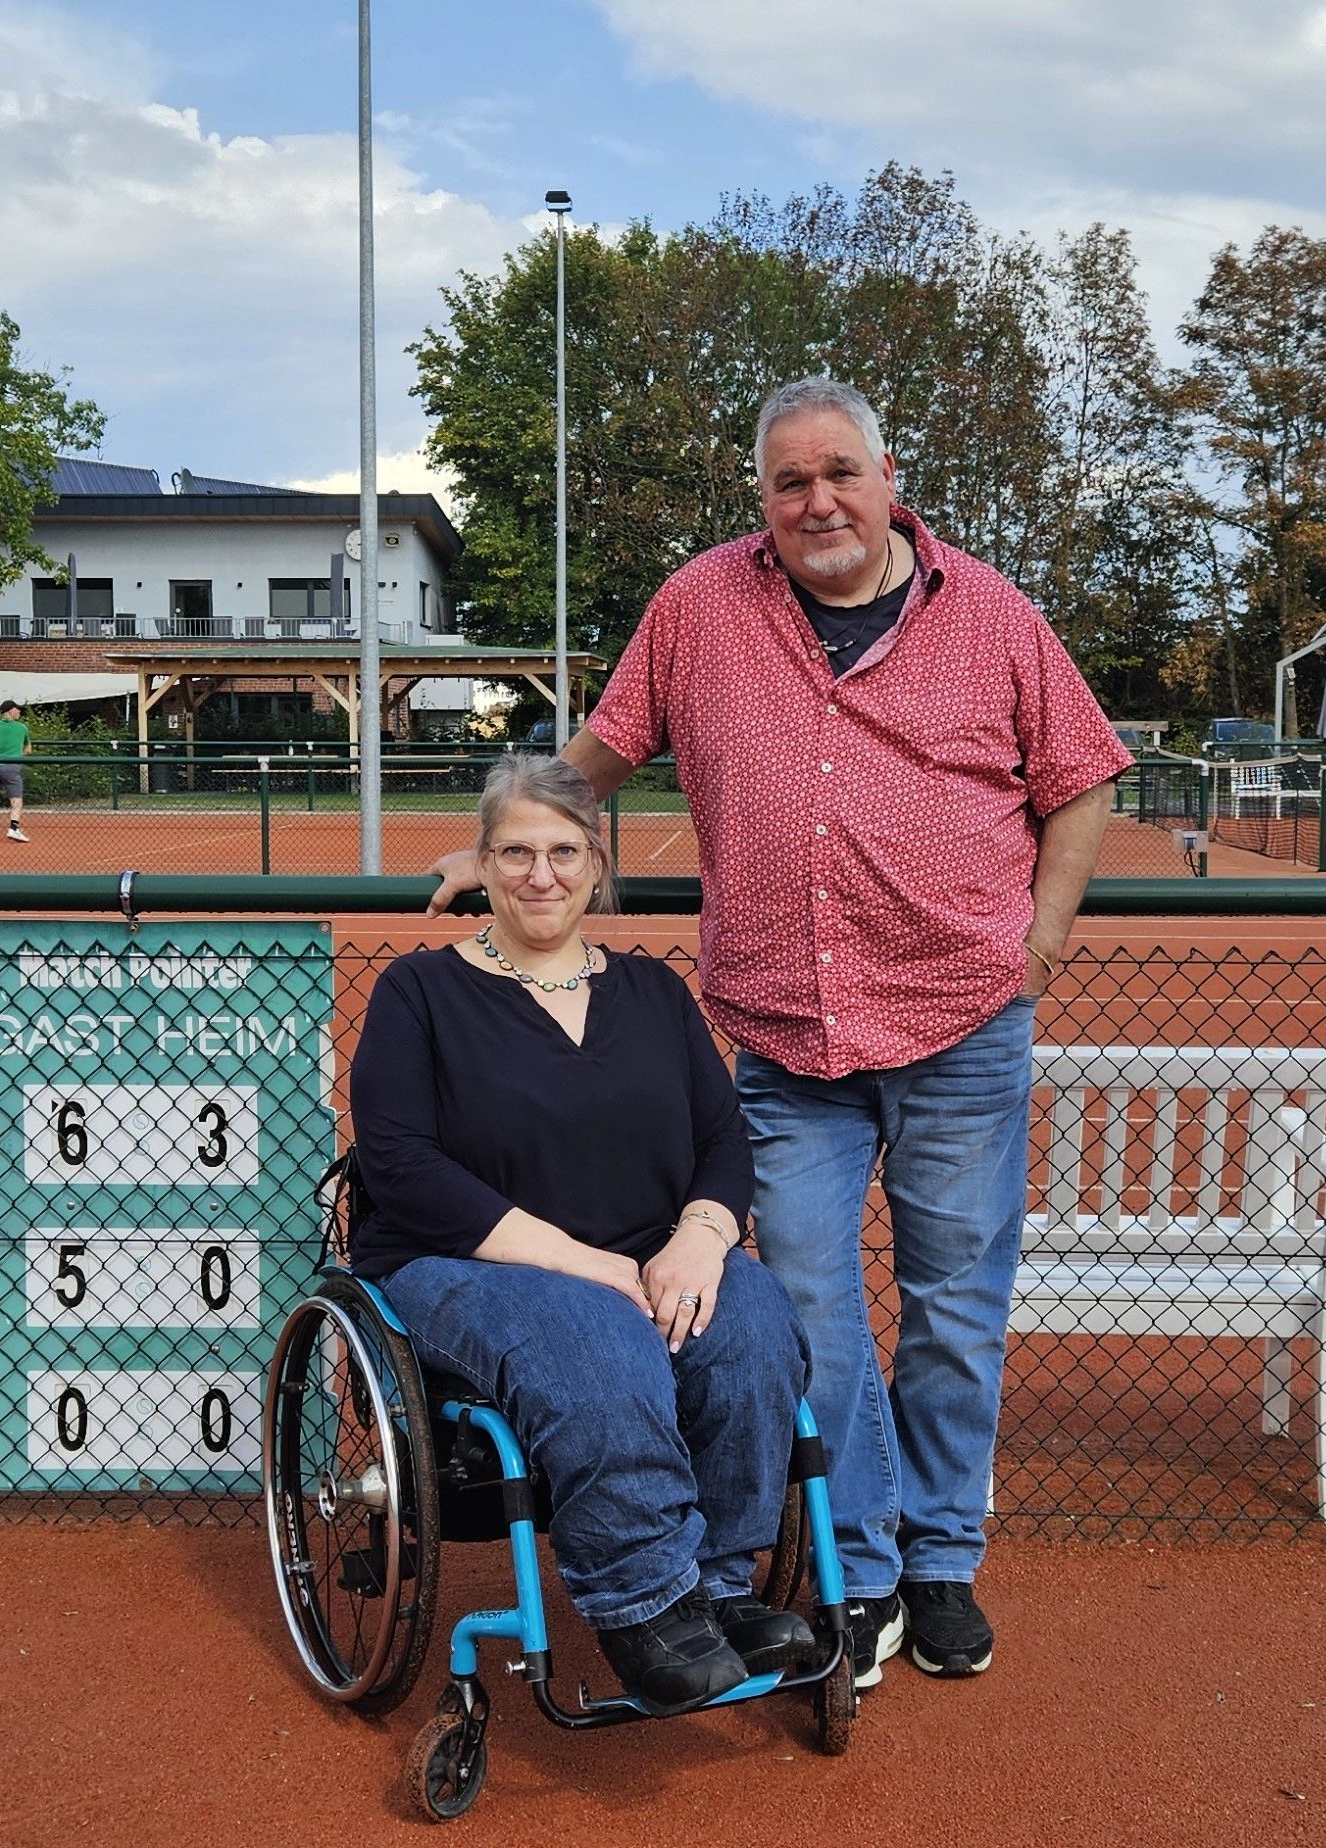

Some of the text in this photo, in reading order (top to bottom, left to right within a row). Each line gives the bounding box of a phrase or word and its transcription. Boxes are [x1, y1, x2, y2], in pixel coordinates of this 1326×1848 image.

[19, 950, 252, 989] Match Pointer
[156, 1015, 296, 1056] HEIM
[58, 1101, 227, 1167] 6 3
[56, 1245, 230, 1310] 5 0
[58, 1387, 230, 1452] 0 0
